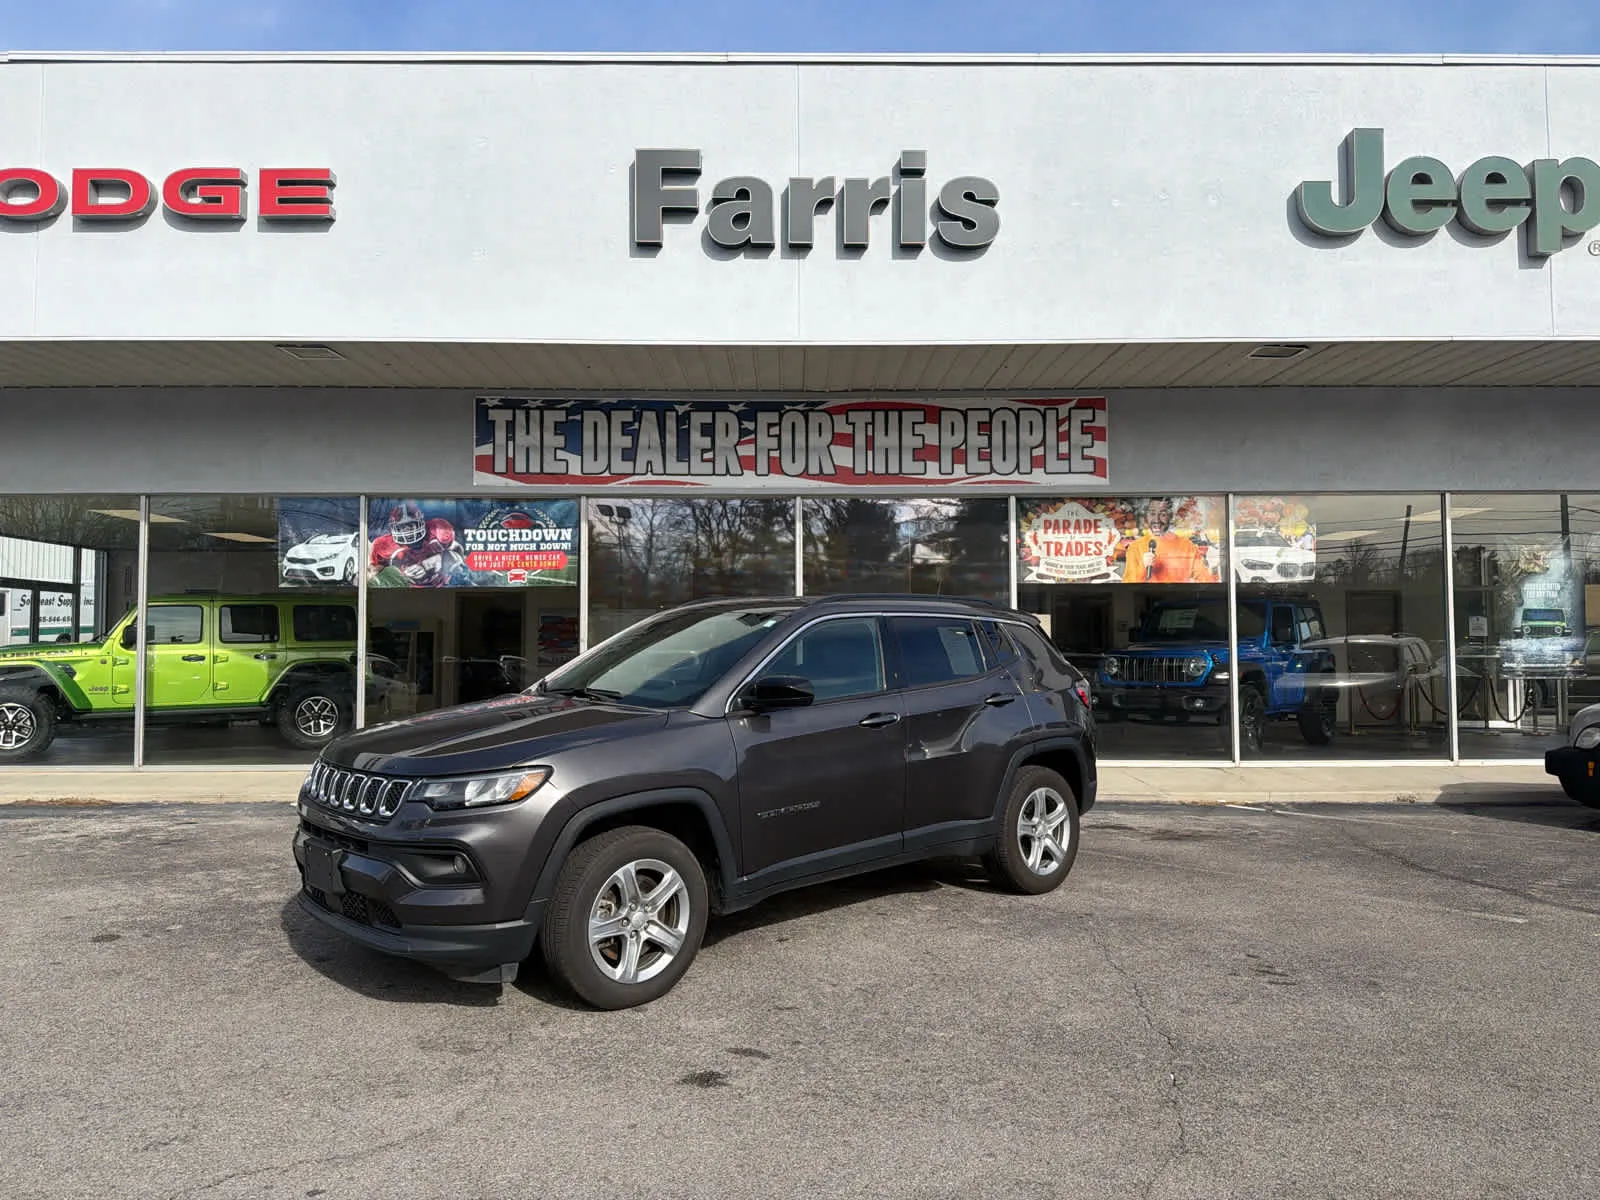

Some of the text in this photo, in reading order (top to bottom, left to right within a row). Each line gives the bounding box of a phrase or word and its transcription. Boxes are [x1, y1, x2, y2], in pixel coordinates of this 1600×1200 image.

[1297, 127, 1600, 255] Jeep
[633, 148, 1001, 252] Farris
[486, 407, 1097, 477] THE DEALER FOR THE PEOPLE
[464, 528, 572, 541] TOUCHDOWN
[1043, 519, 1103, 535] PARADE
[465, 542, 571, 551] FOR NOT MUCH DOWN!
[1043, 541, 1104, 557] TRADES
